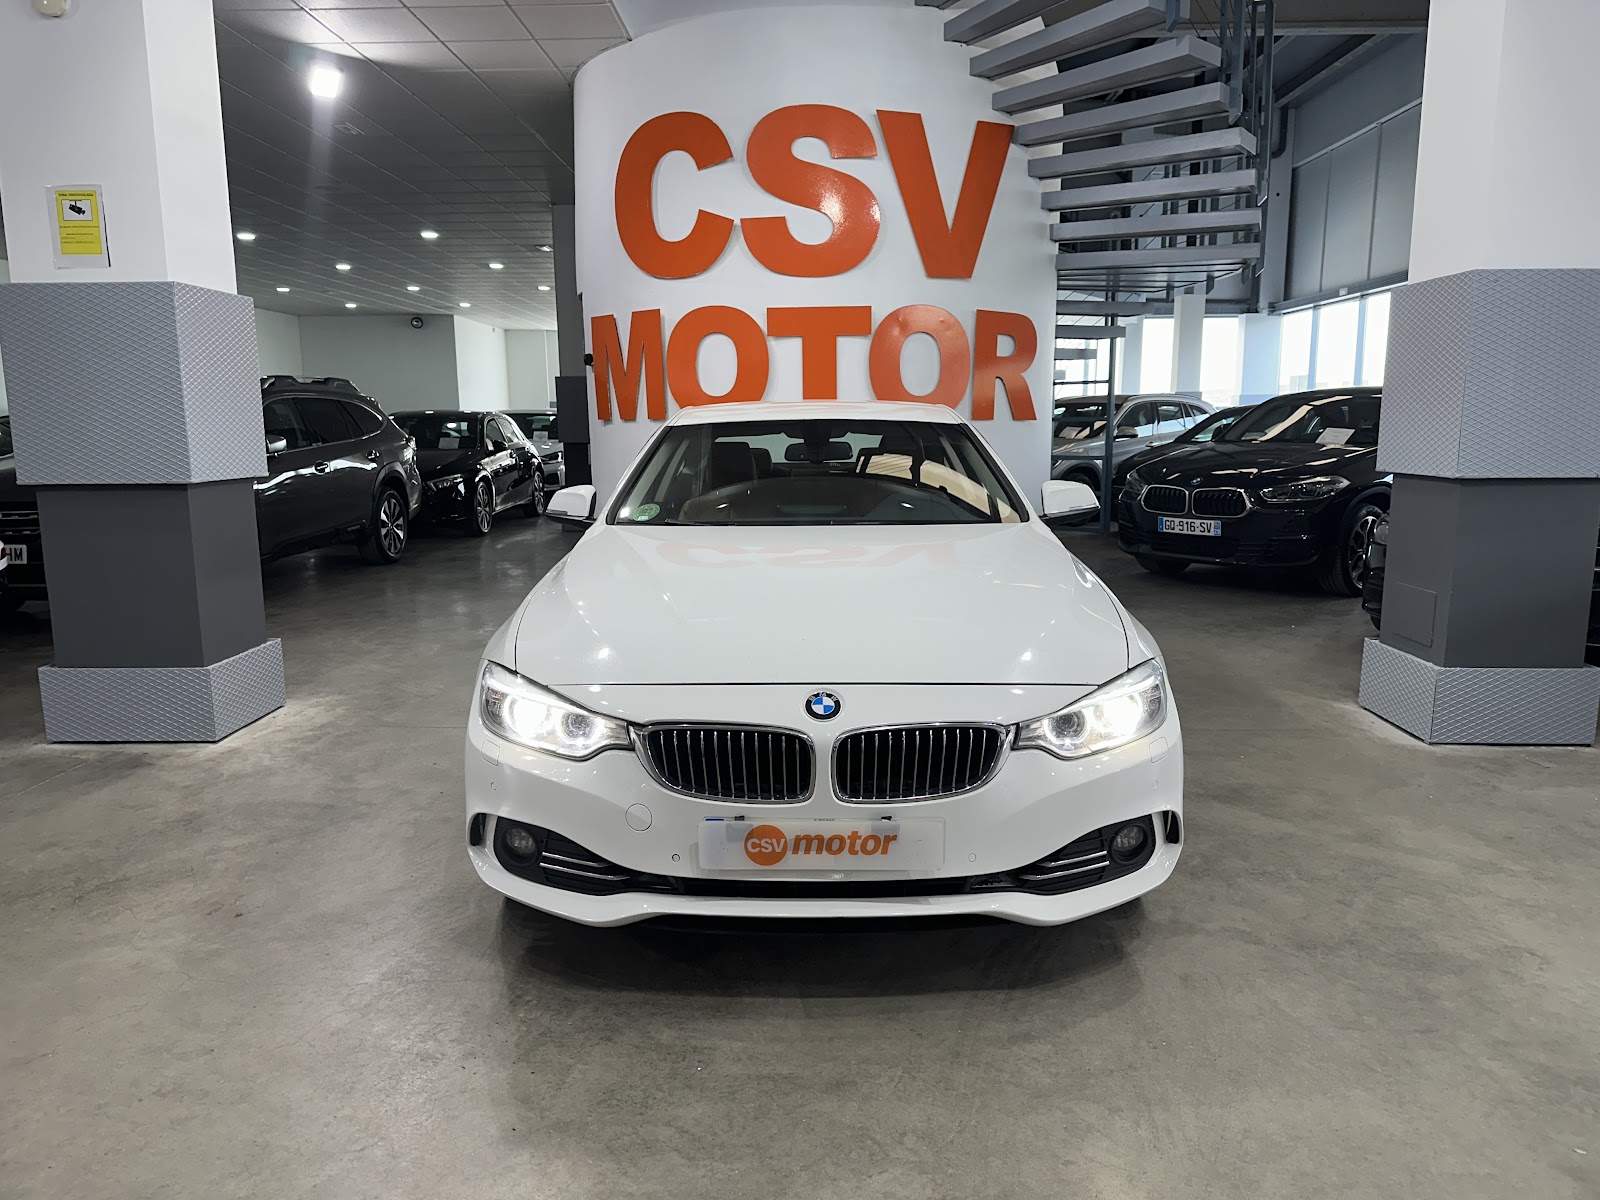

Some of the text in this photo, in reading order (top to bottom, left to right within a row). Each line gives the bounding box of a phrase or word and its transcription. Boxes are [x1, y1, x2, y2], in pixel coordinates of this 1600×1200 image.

[614, 104, 1015, 279] CSV
[590, 304, 1038, 421] MOTOR
[1164, 519, 1212, 533] GQ-916-SV
[746, 830, 898, 856] CSV motor
